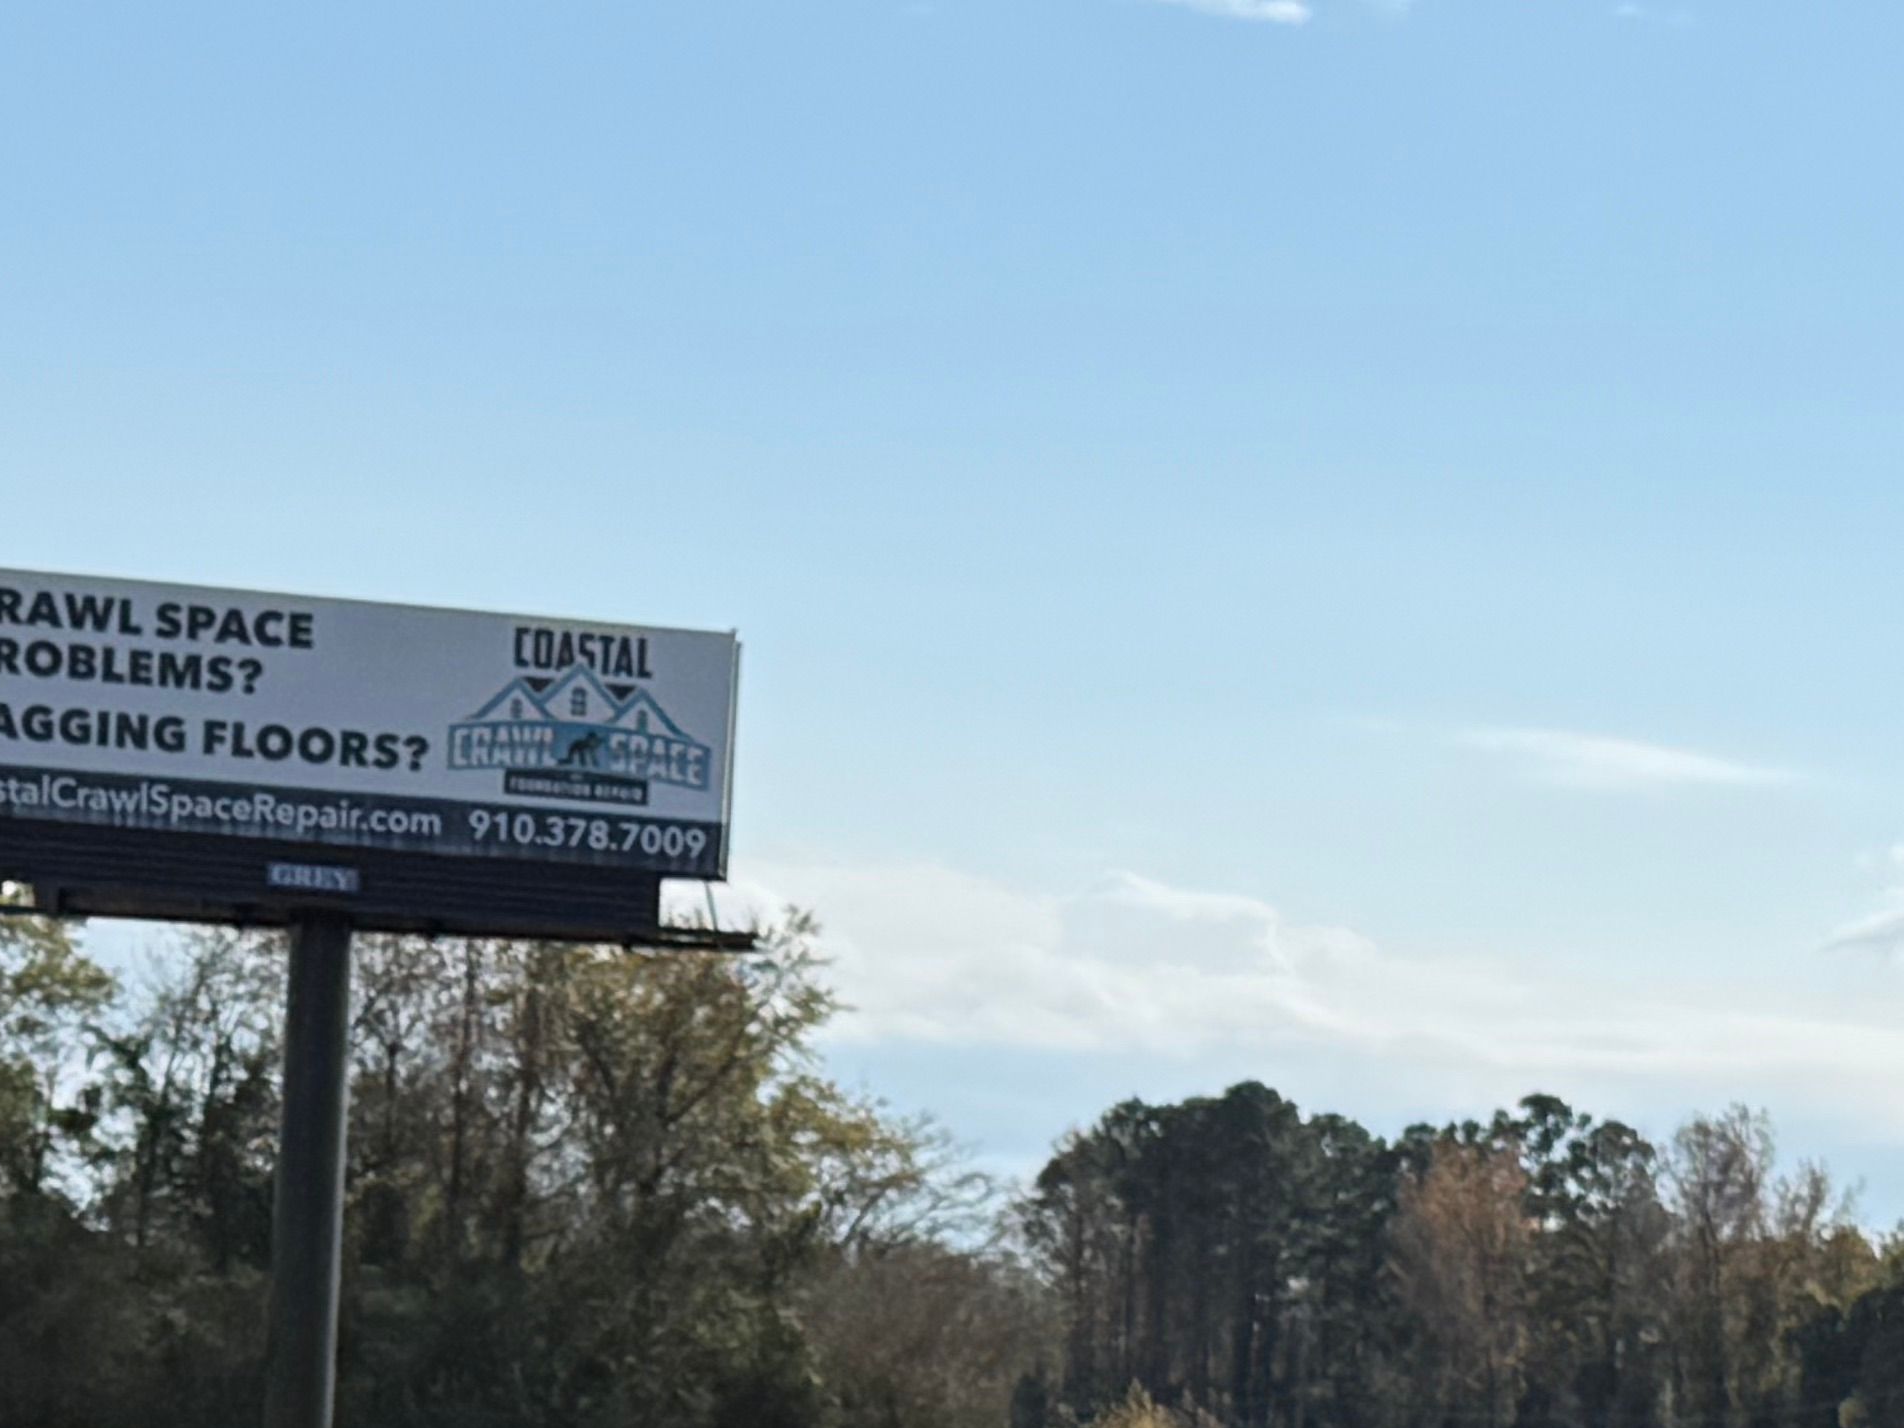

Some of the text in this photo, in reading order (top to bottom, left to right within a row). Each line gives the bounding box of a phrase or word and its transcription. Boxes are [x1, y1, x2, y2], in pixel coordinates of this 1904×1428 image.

[154, 601, 315, 650] SPACE
[513, 626, 653, 680] COASTAL
[201, 718, 430, 772] FLOORS?
[452, 725, 704, 787] CRAWL SPACE
[468, 809, 707, 858] 910.378.7009
